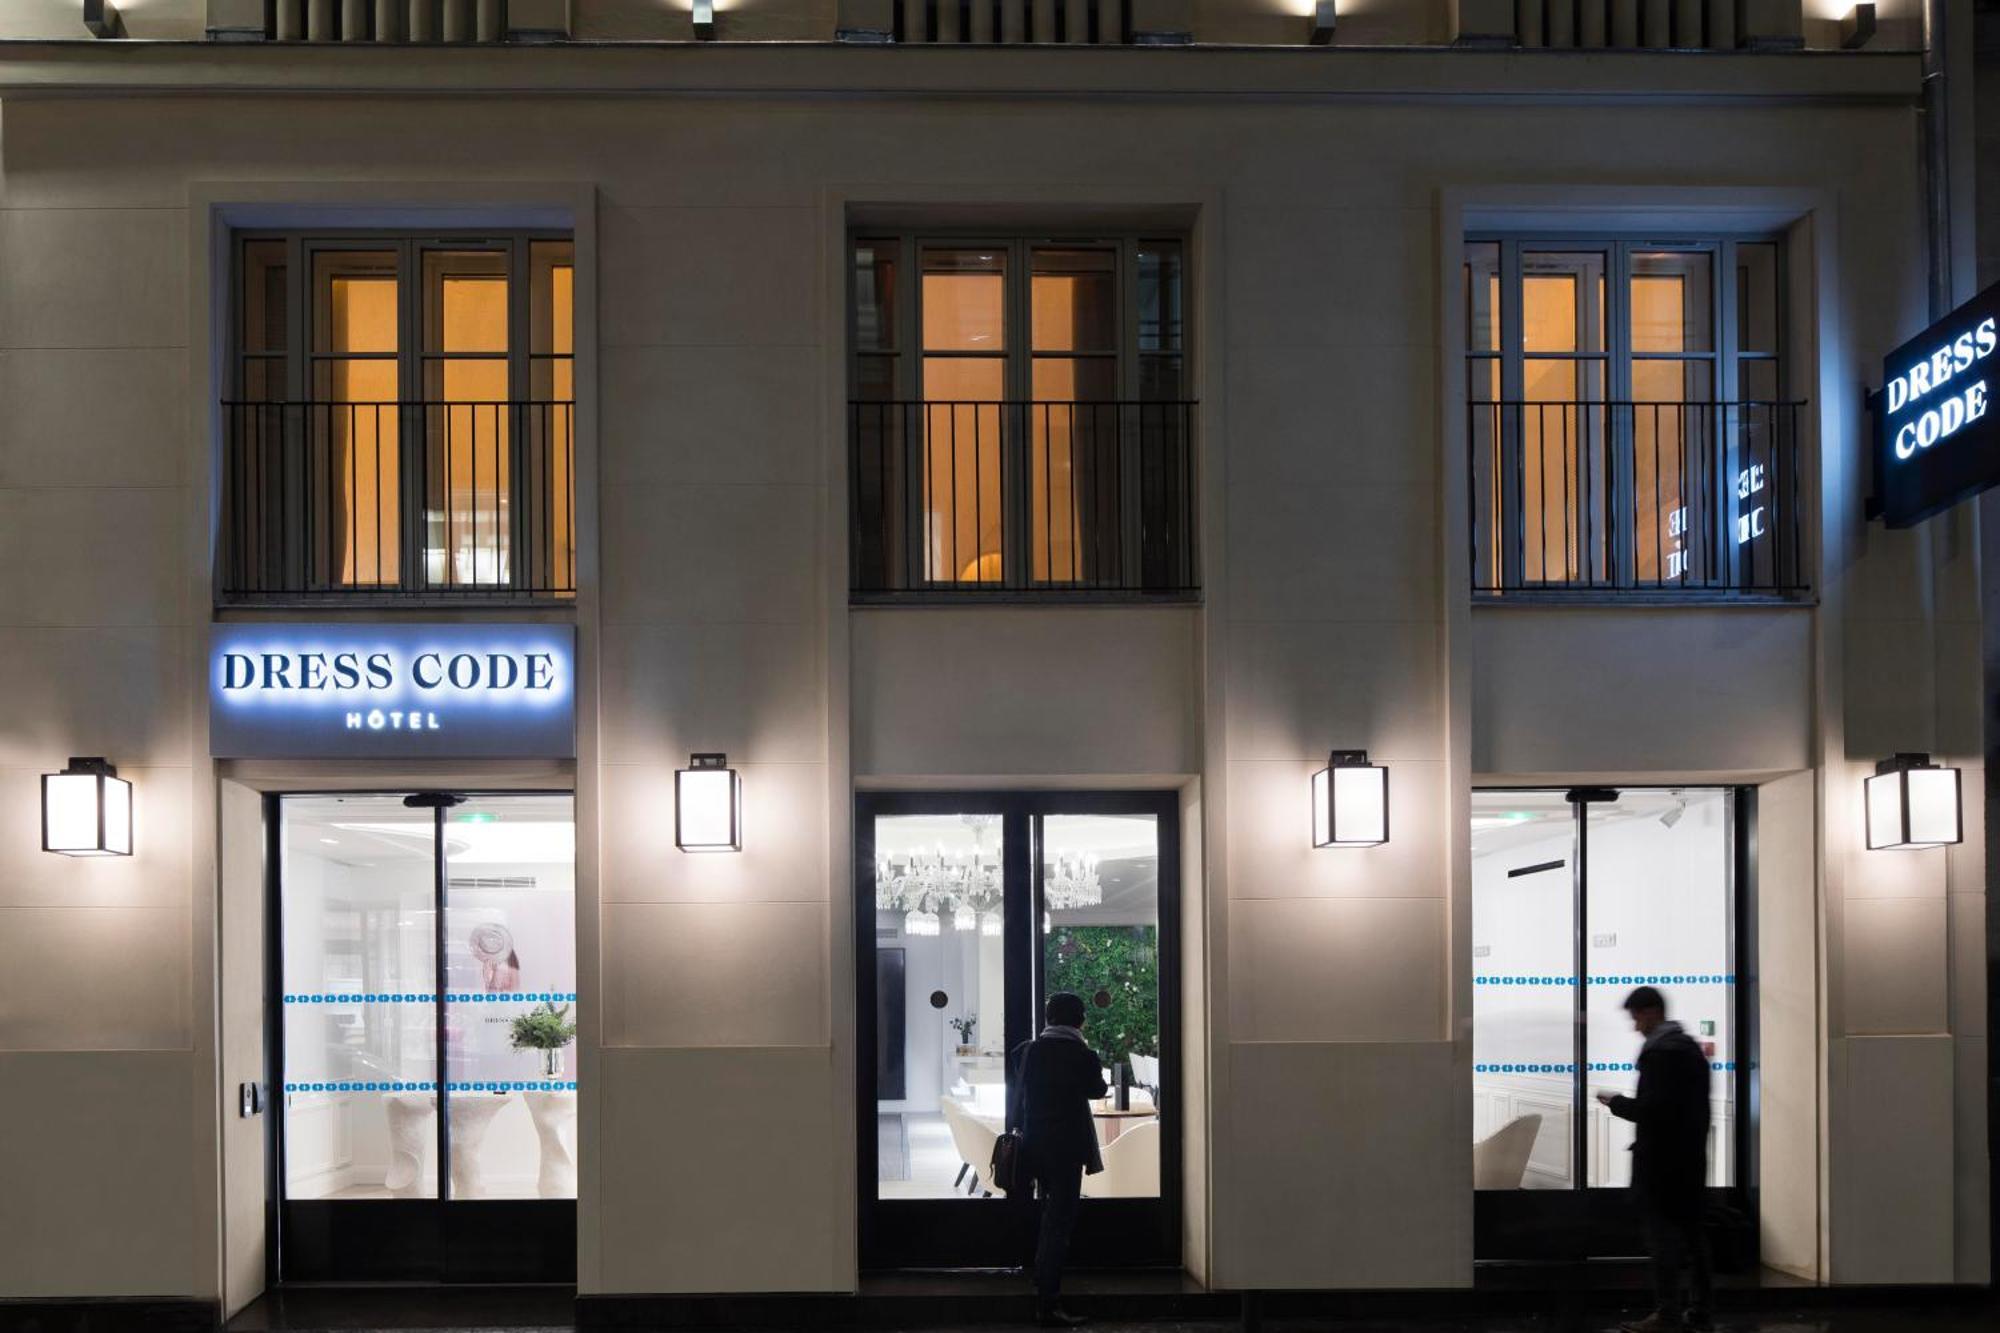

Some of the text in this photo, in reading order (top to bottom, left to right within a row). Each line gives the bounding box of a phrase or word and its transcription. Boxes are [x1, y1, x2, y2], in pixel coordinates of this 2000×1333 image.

[1887, 317, 1997, 415] DRESS
[1895, 380, 1987, 460] CODE
[223, 653, 554, 690] DRESS CODE
[346, 709, 440, 729] HÔTEL
